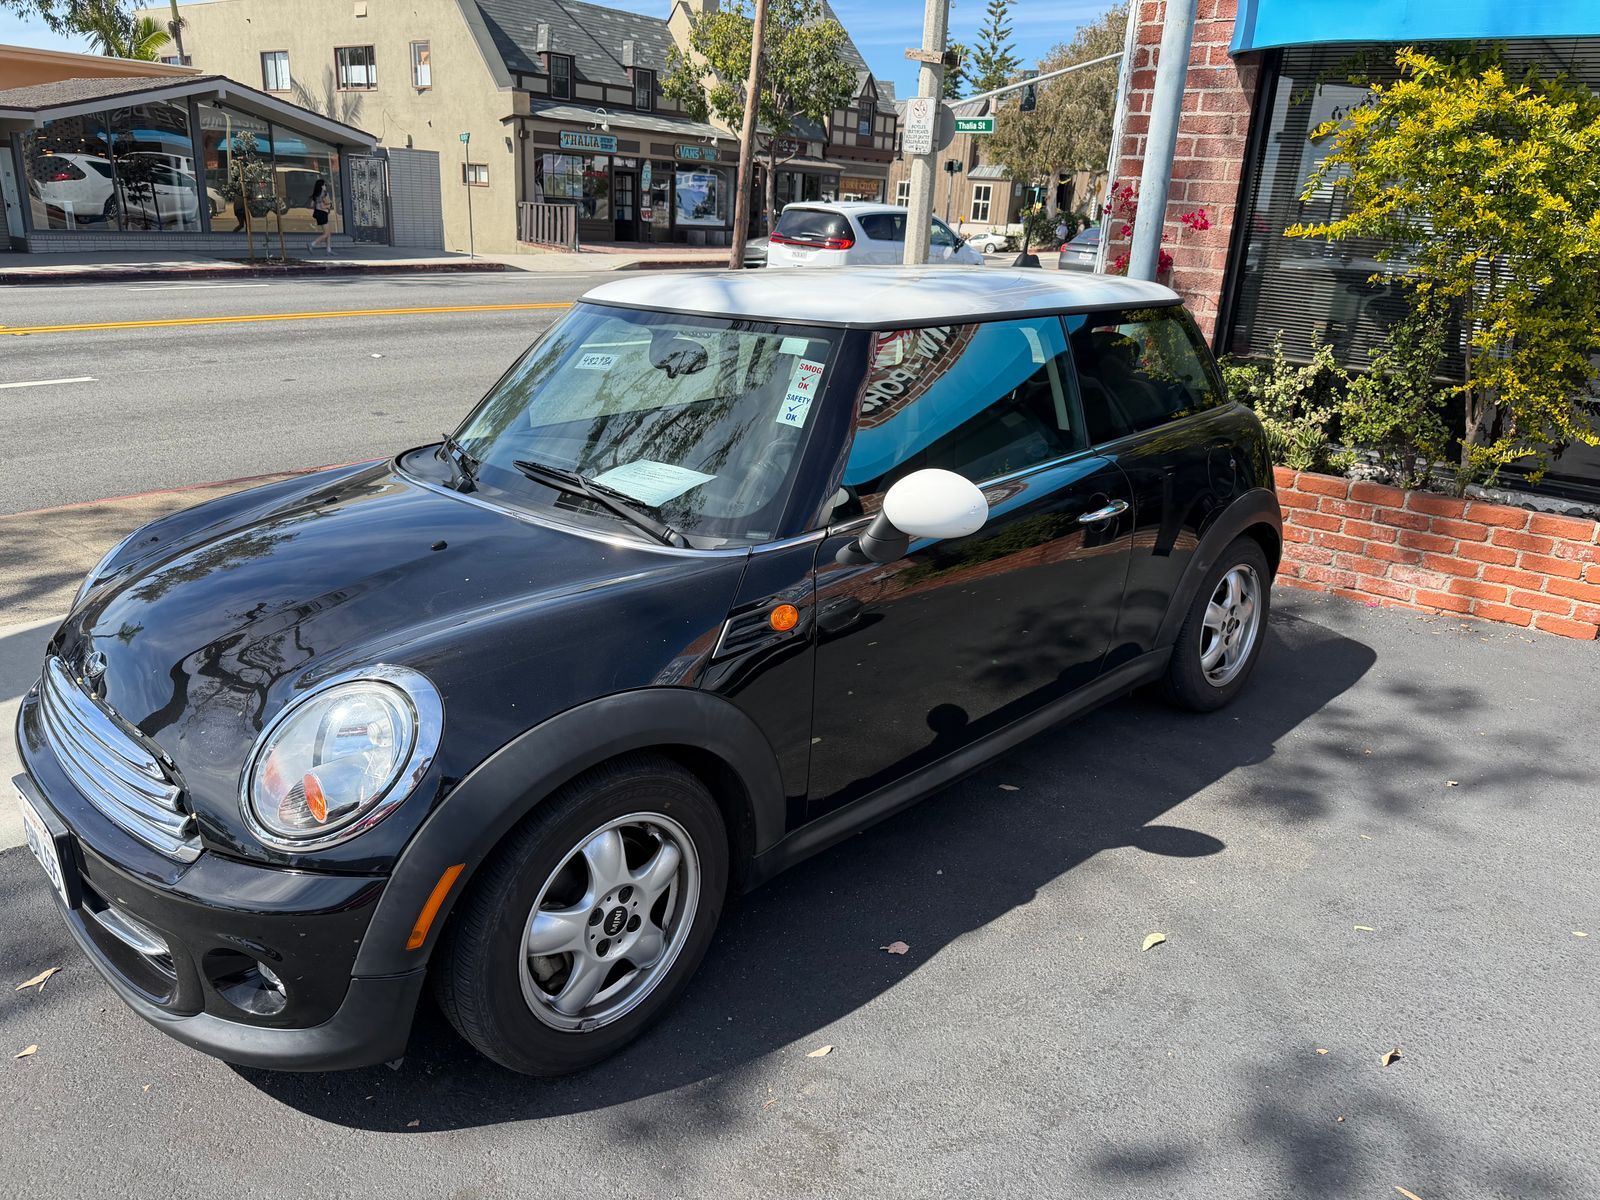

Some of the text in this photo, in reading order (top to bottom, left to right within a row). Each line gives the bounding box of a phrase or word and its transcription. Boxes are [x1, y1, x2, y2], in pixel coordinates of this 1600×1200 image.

[958, 121, 986, 130] Thalia St
[563, 133, 600, 148] THALIA
[680, 145, 699, 159] VANS
[799, 362, 822, 375] SMOG
[797, 381, 810, 391] OK
[786, 393, 811, 405] SAFETY
[785, 413, 798, 422] OK
[610, 910, 622, 932] MINI
